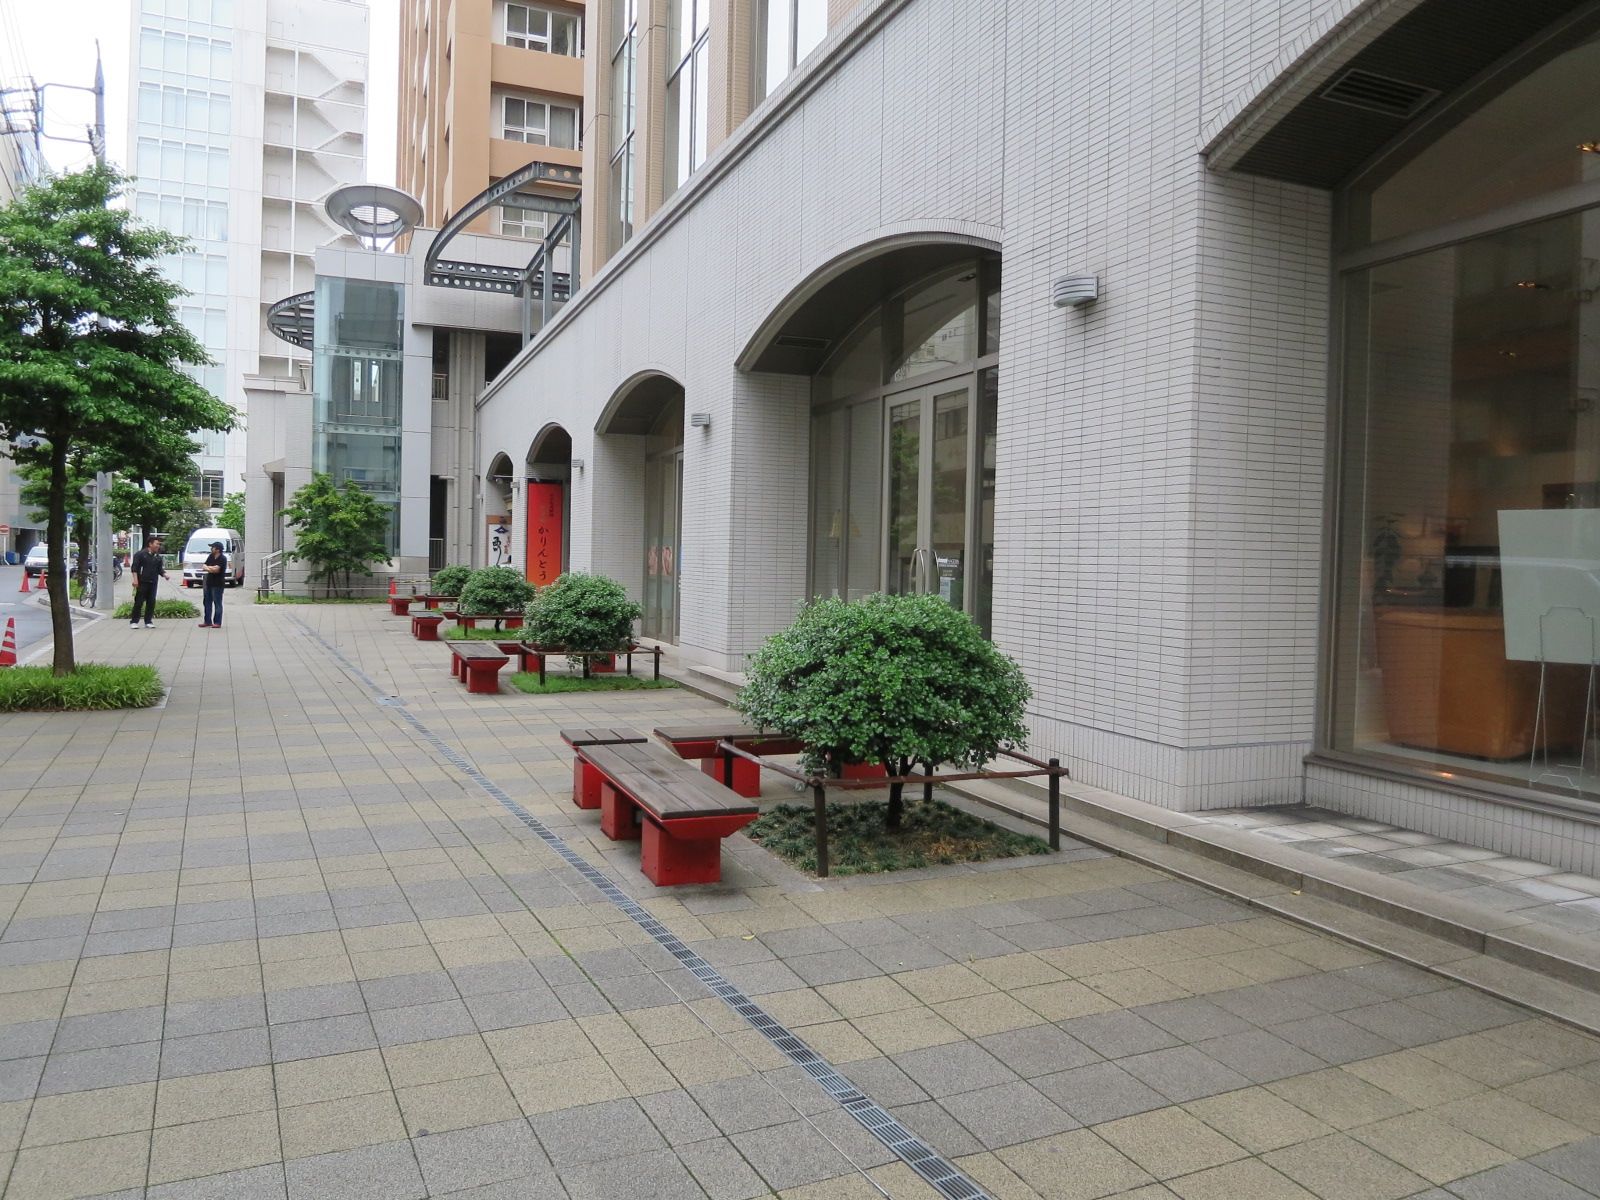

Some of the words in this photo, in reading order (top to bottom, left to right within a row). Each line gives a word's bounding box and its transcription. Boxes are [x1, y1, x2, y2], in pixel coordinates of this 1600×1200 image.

[537, 526, 549, 581] かりんとう
